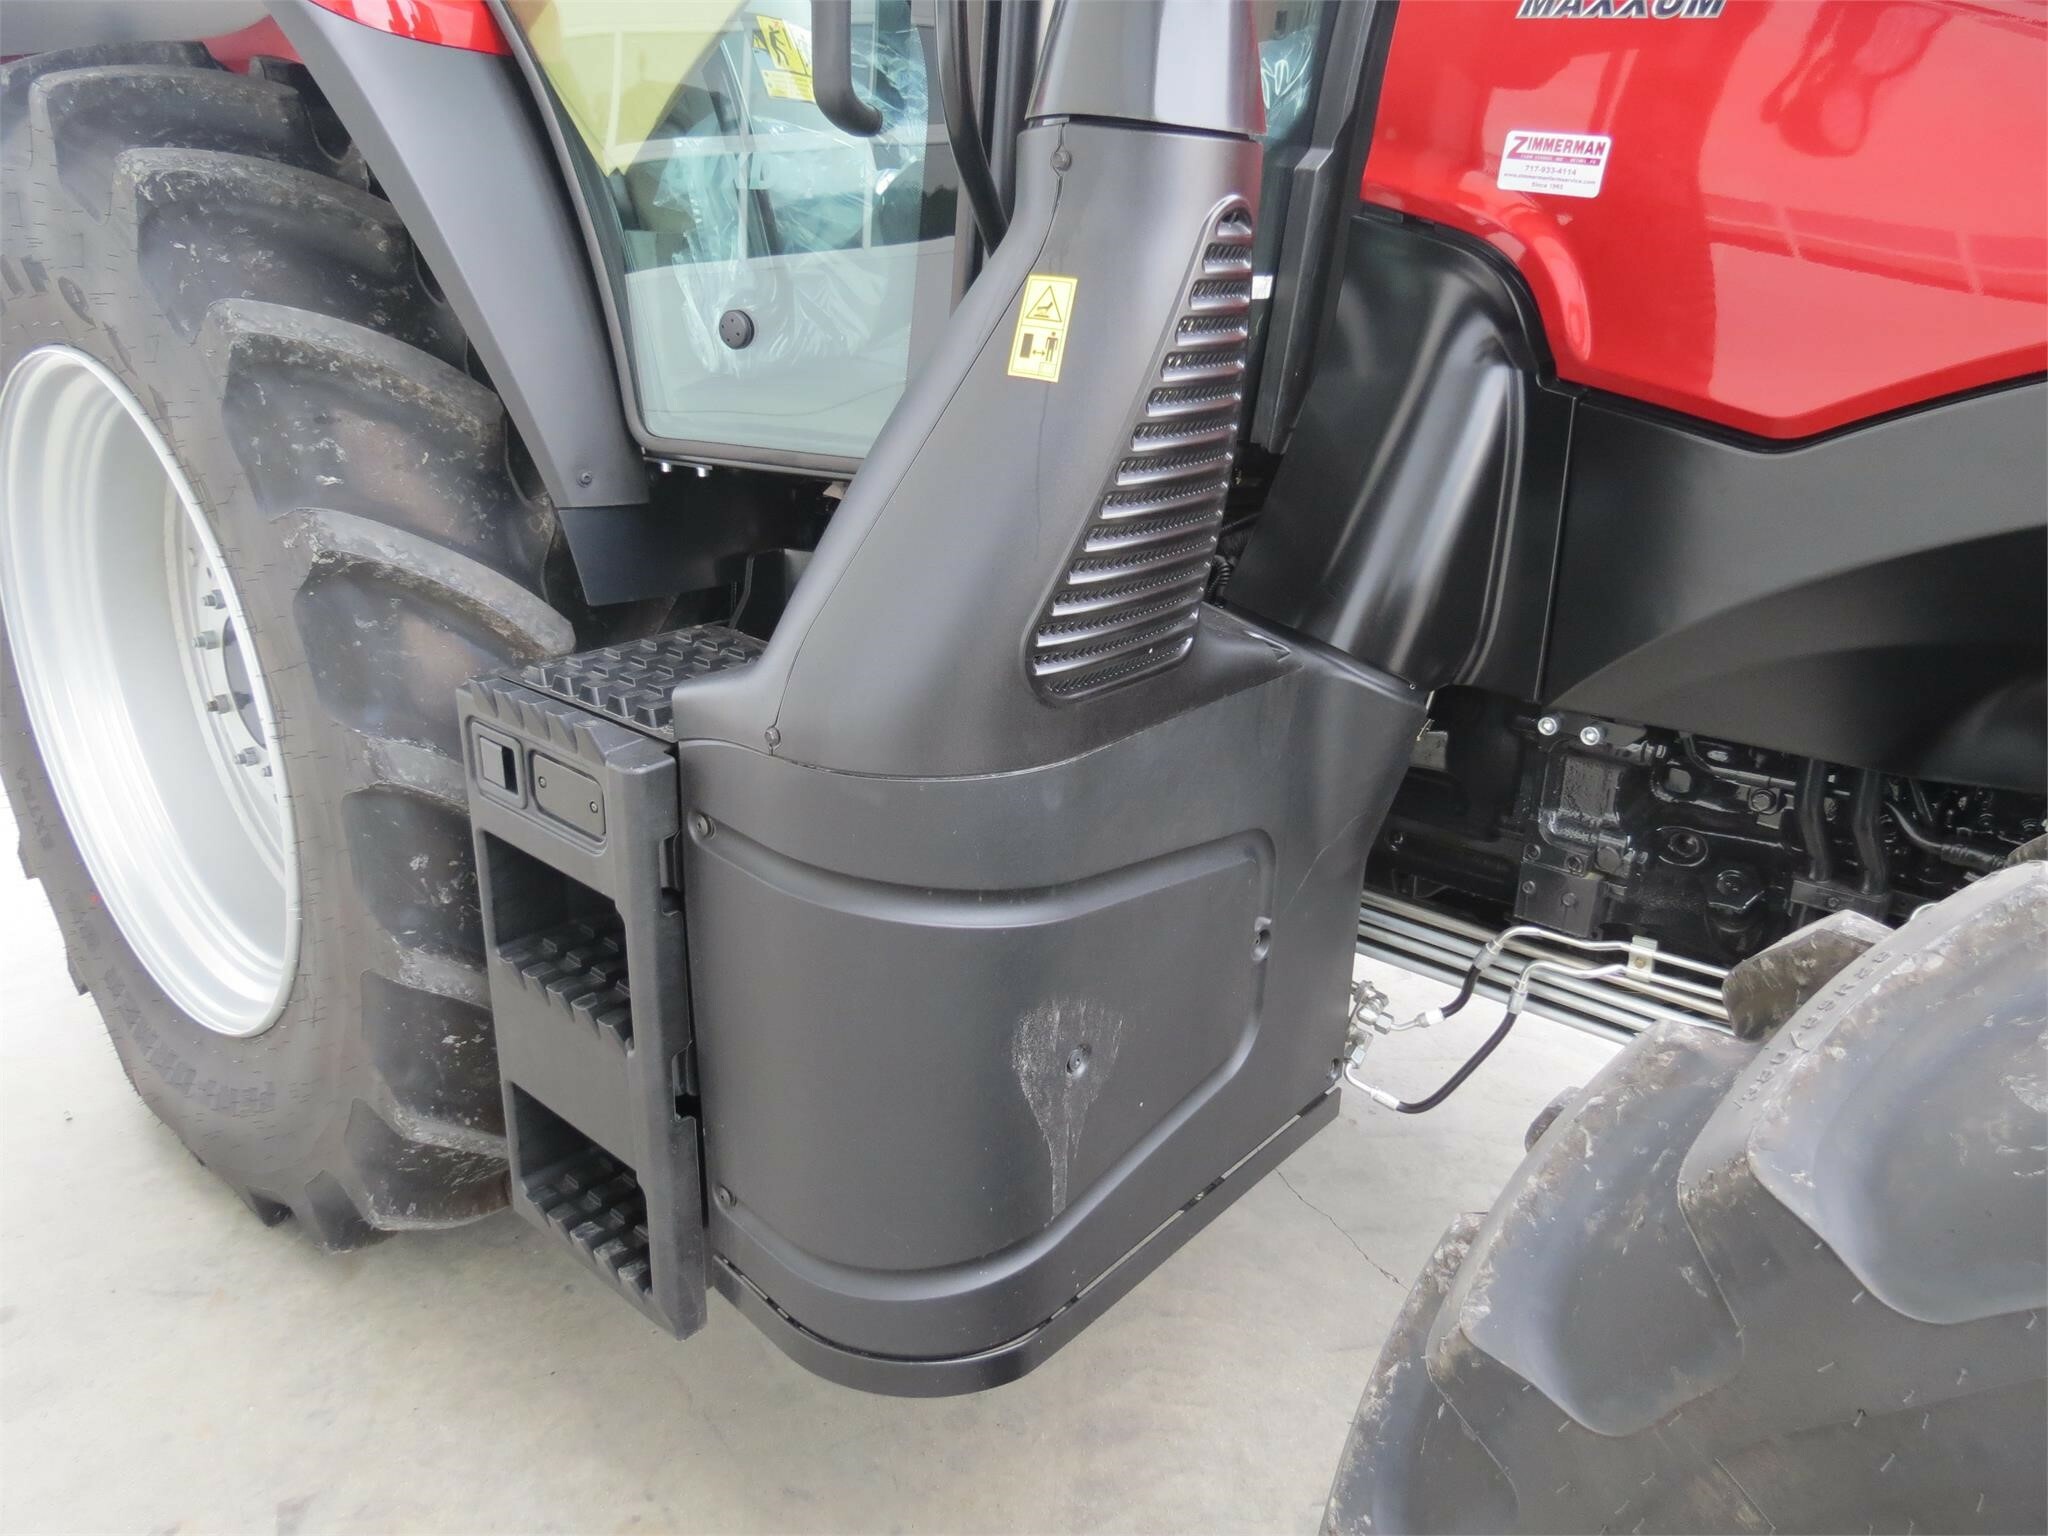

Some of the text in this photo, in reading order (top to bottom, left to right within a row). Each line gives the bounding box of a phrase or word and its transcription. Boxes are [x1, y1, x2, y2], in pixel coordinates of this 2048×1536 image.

[1515, 0, 1725, 19] MAXXUM
[1507, 136, 1606, 159] ZIMMERMAN
[1525, 165, 1577, 175] 717-933-4114
